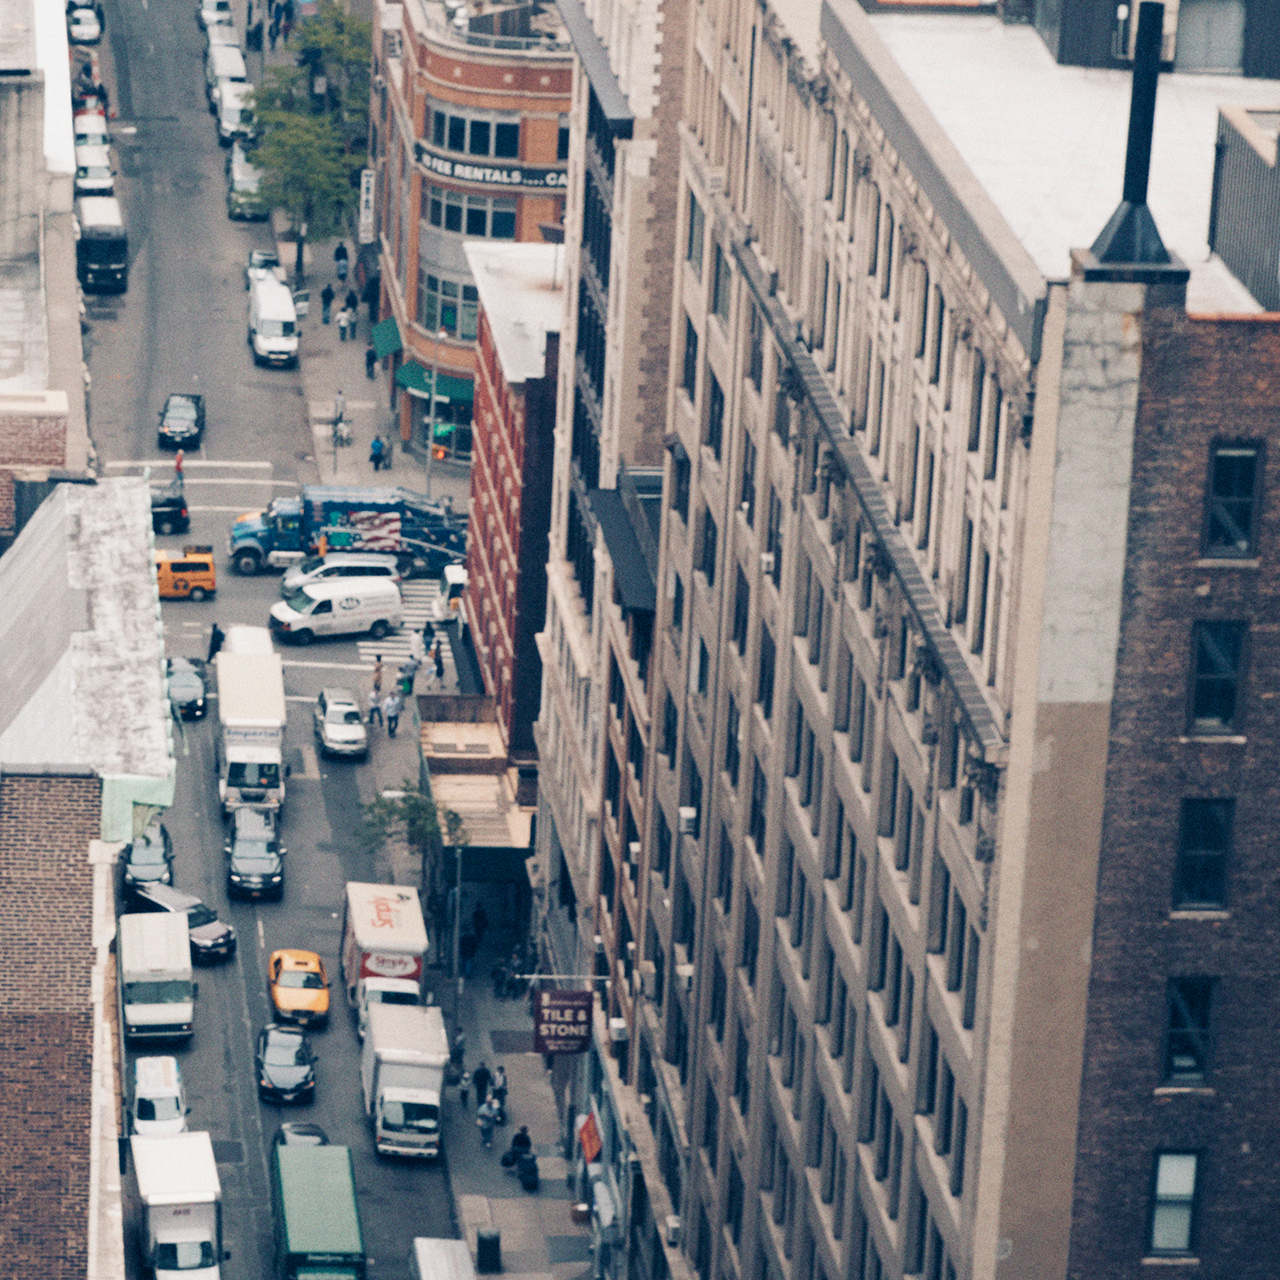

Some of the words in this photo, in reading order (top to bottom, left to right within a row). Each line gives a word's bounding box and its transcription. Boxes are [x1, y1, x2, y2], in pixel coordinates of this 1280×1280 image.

[541, 1008, 574, 1022] TILE
[576, 1009, 588, 1022] &
[539, 1024, 588, 1037] STONE
